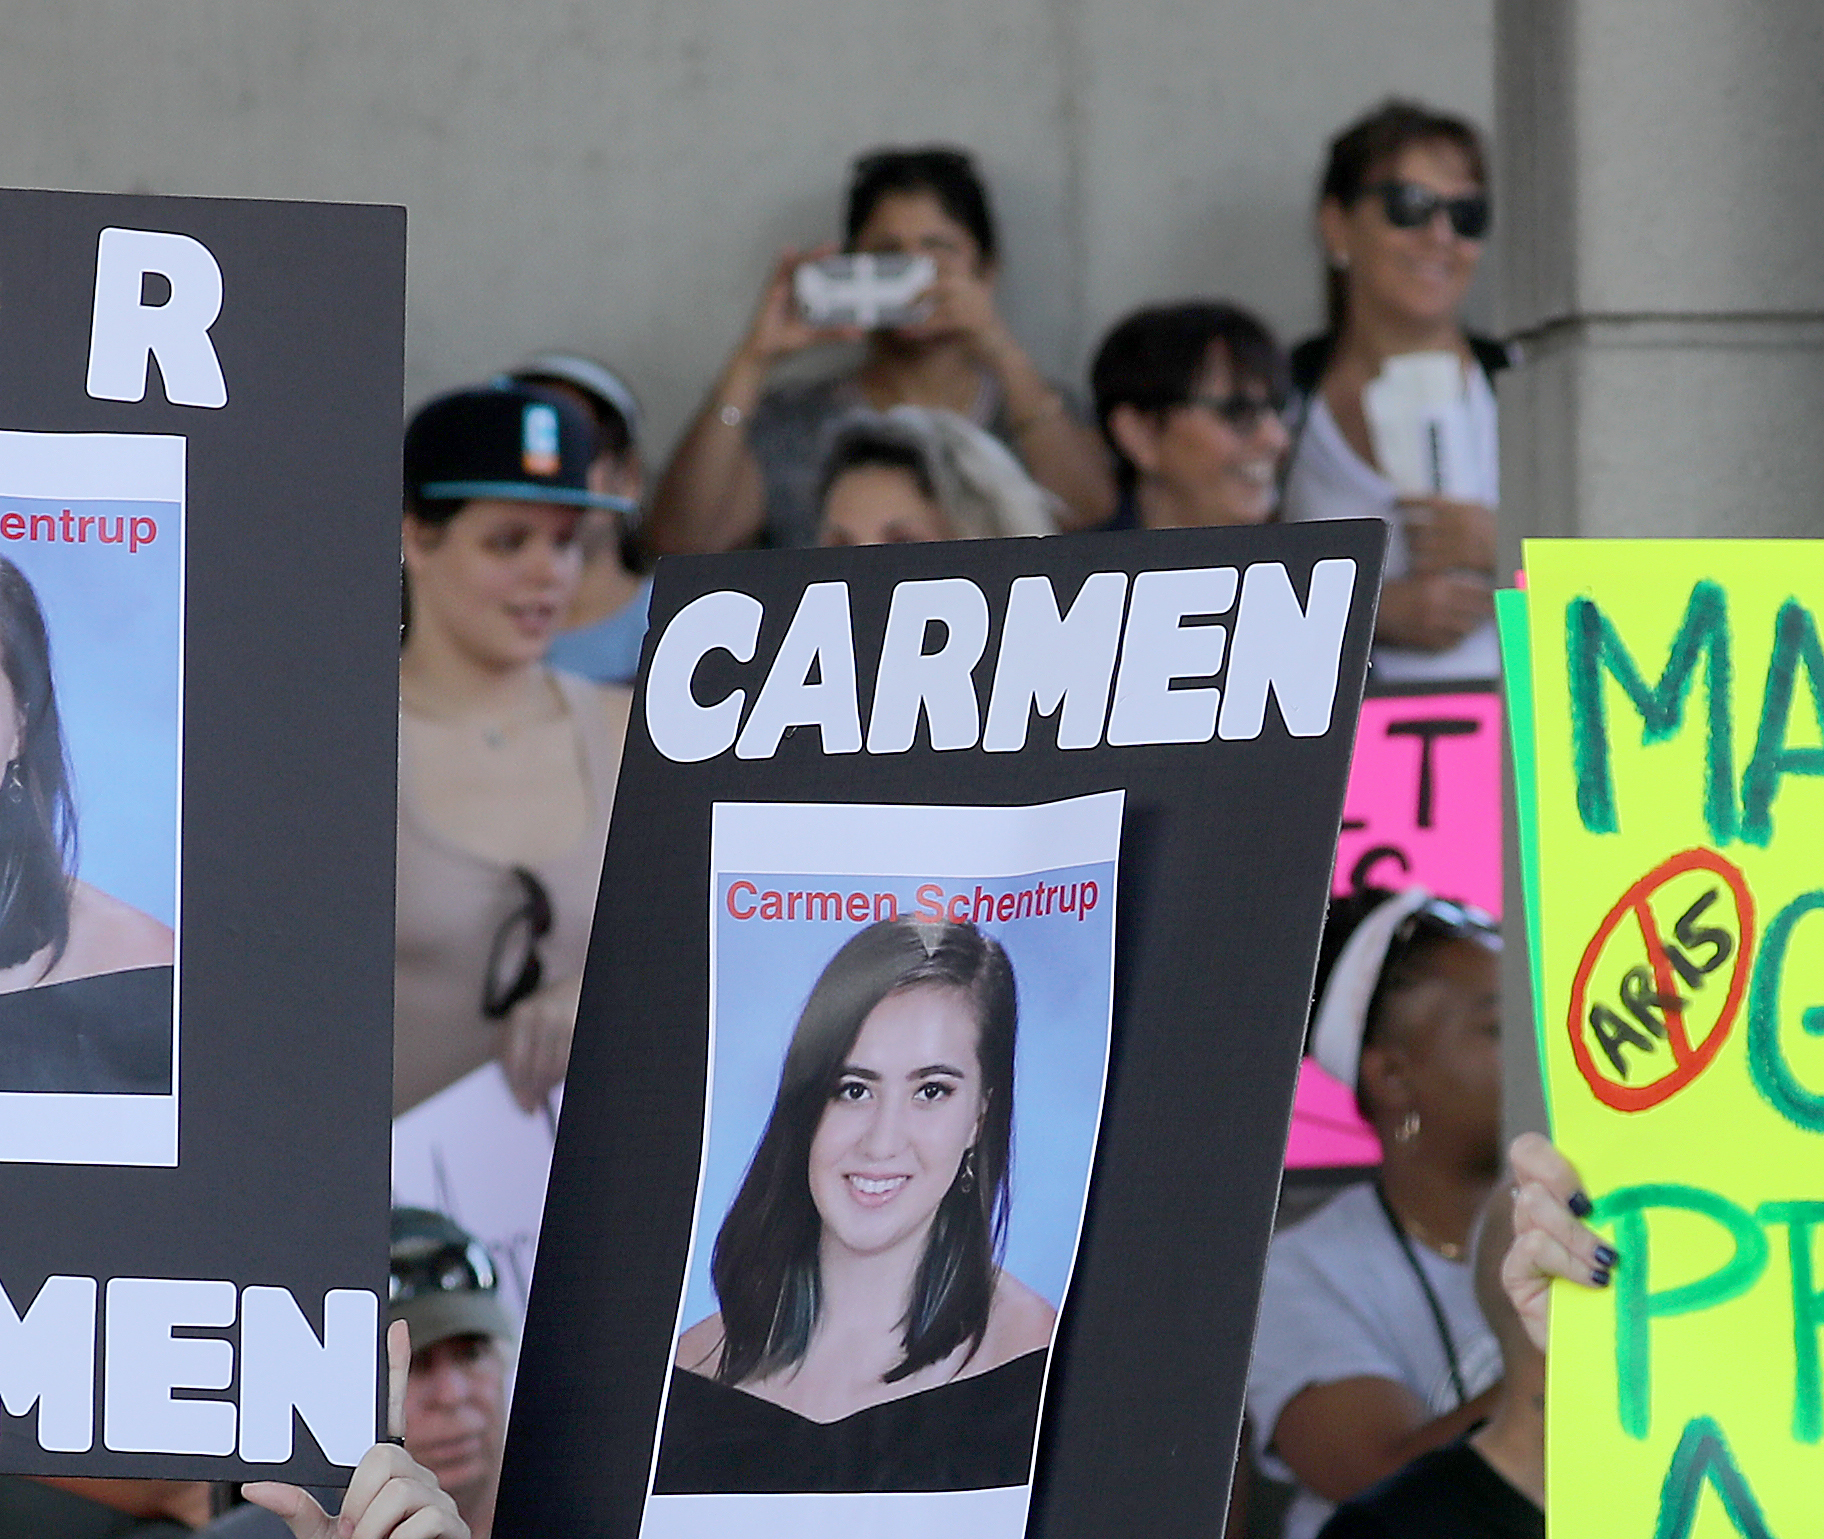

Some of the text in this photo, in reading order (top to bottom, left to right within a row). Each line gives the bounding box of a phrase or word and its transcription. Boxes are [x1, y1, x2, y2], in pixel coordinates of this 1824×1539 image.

[645, 558, 1356, 763] CARMEN
[724, 877, 1100, 926] Carmen Schentrup
